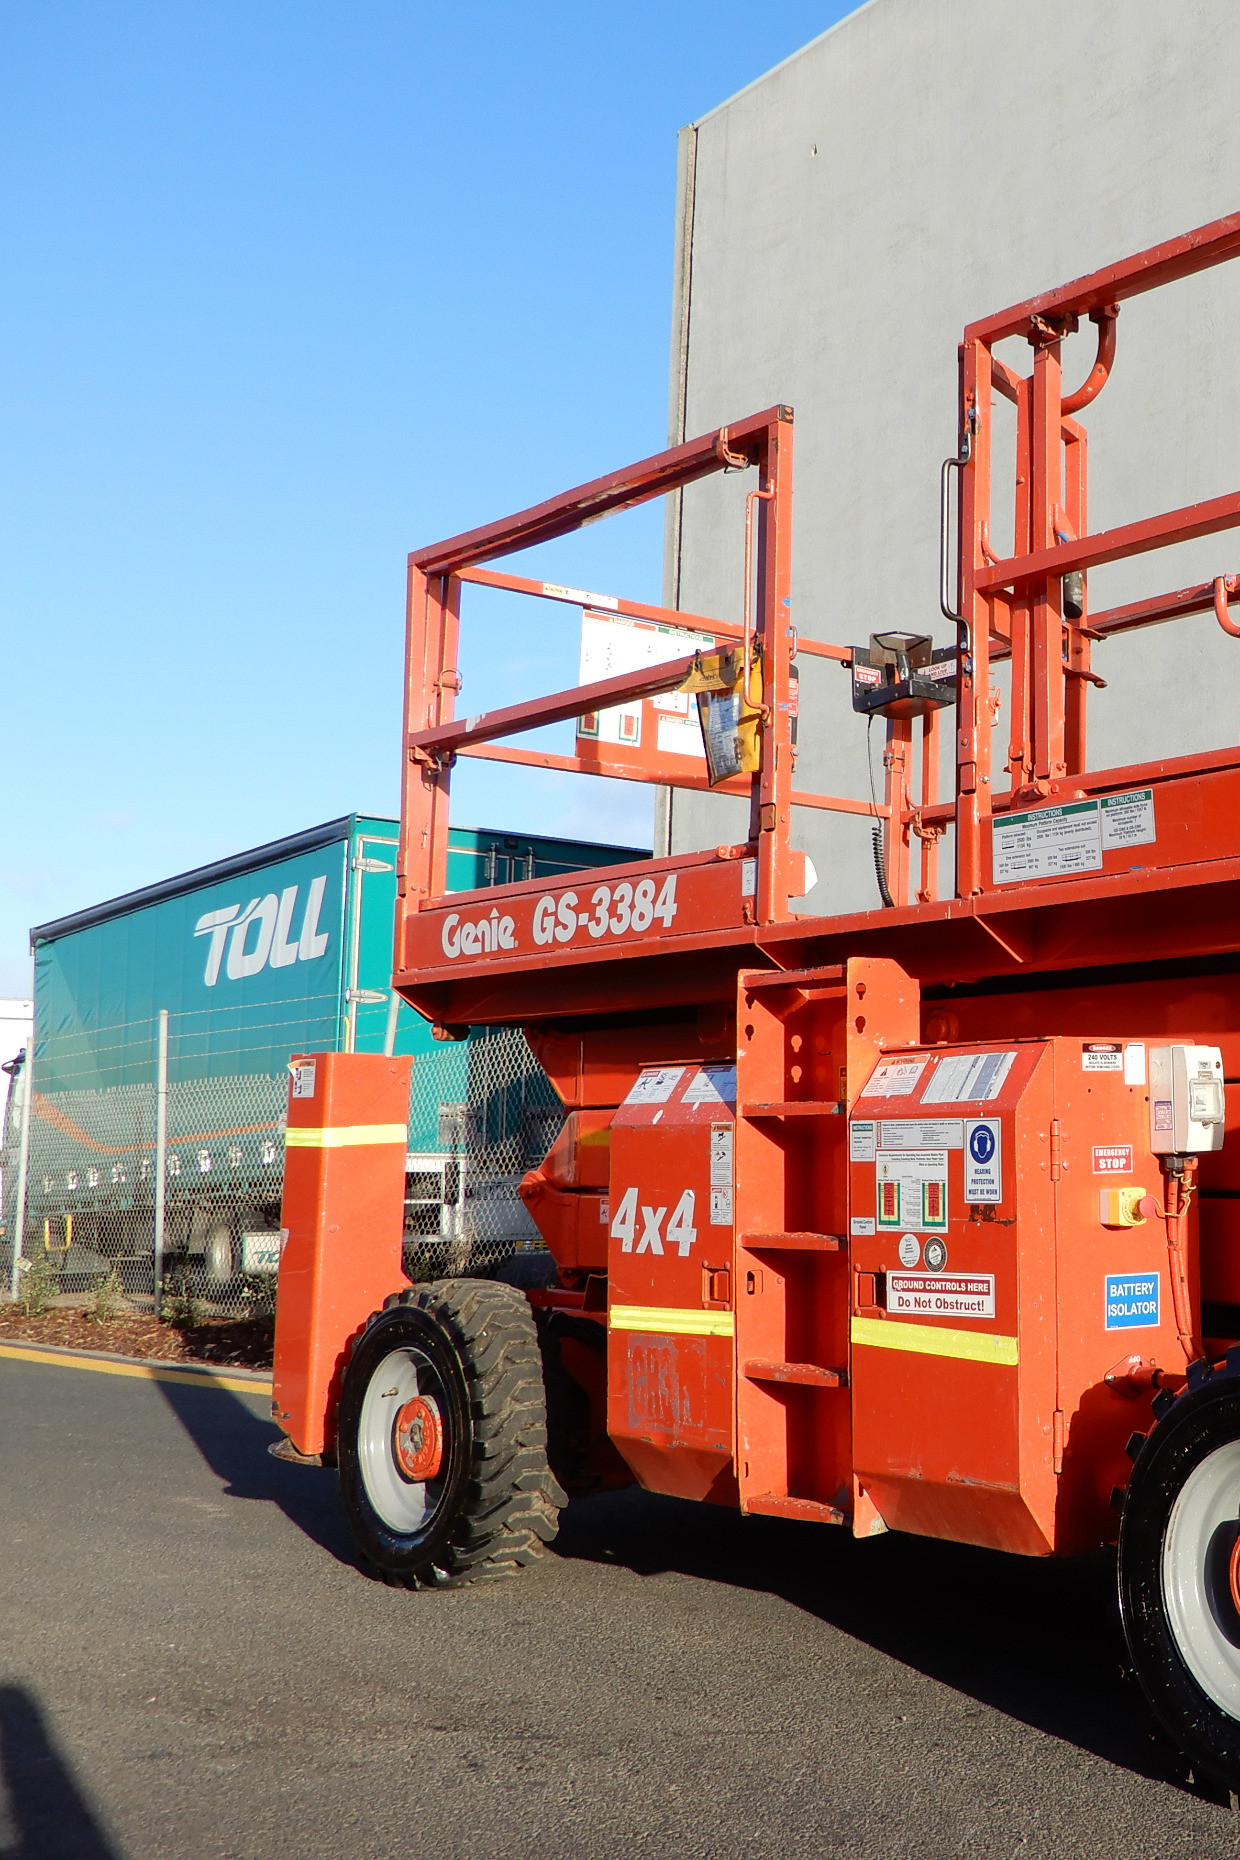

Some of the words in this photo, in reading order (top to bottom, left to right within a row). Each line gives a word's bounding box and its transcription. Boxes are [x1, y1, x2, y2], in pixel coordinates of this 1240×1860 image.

[858, 673, 877, 681] STOP
[1108, 792, 1145, 806] INSTRUCTIONS
[1027, 808, 1063, 821] INSTRUCTIONS
[1053, 817, 1068, 825] Capacity
[441, 908, 515, 958] Genie
[532, 875, 677, 946] GS-3384
[194, 875, 330, 987] TOLL
[1095, 1148, 1130, 1157] EMERGENCY
[1099, 1158, 1126, 1169] STOP
[611, 1187, 697, 1256] 4x4
[892, 1279, 924, 1290] GROUND
[925, 1281, 966, 1291] CONTROLS
[967, 1283, 989, 1292] HERE
[1110, 1282, 1154, 1297] BATTERY
[898, 1296, 911, 1308] Do
[914, 1297, 932, 1309] Not
[935, 1297, 985, 1312] Obstruct!
[1108, 1301, 1157, 1317] ISOLATOR
[1128, 1355, 1141, 1363] OFF
